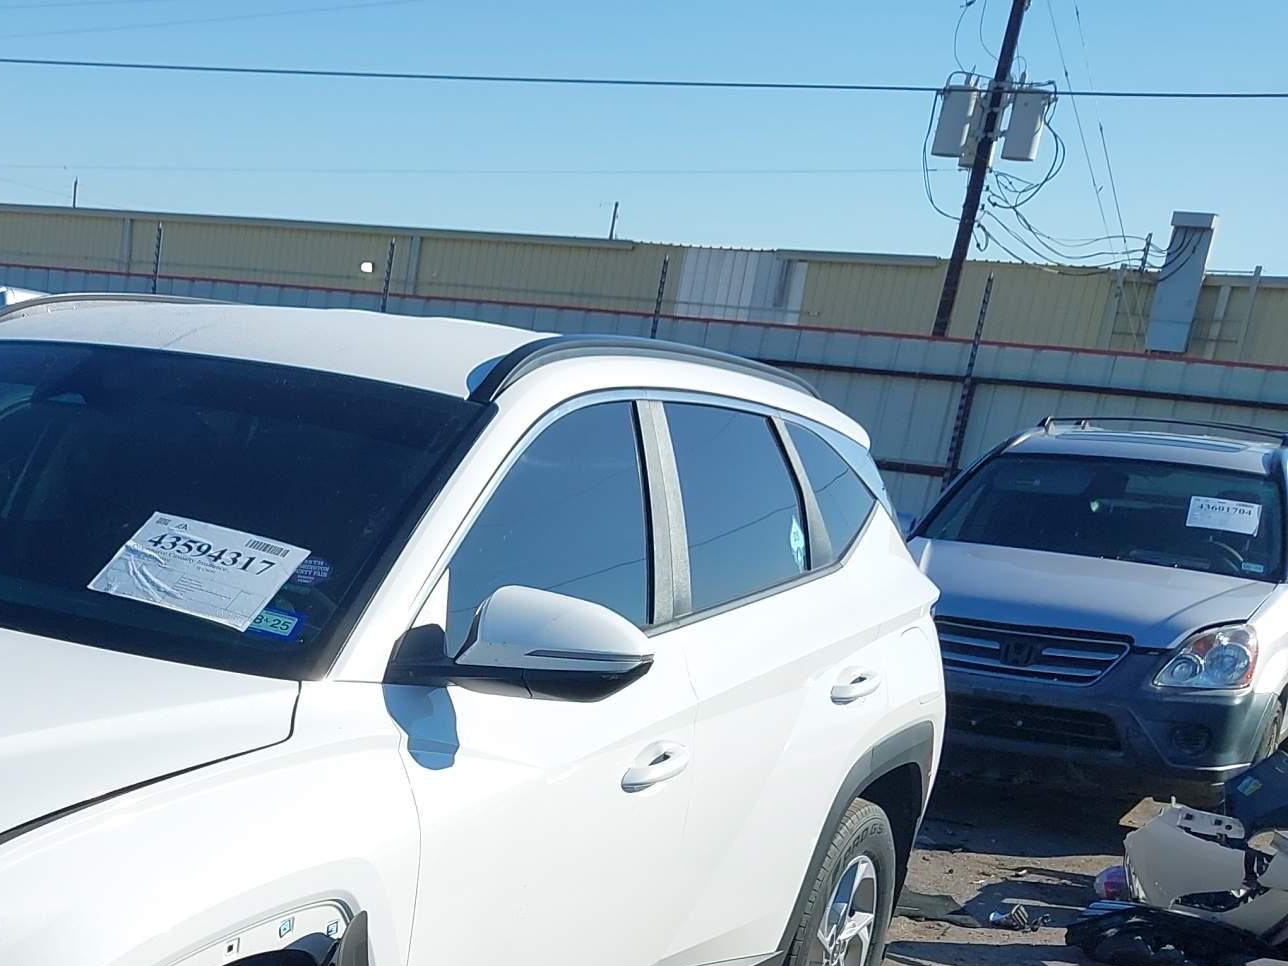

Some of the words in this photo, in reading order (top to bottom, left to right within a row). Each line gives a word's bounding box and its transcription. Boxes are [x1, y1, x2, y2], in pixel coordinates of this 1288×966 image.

[1199, 503, 1252, 516] 43601704
[148, 533, 277, 576] 43594317
[270, 618, 292, 631] 25
